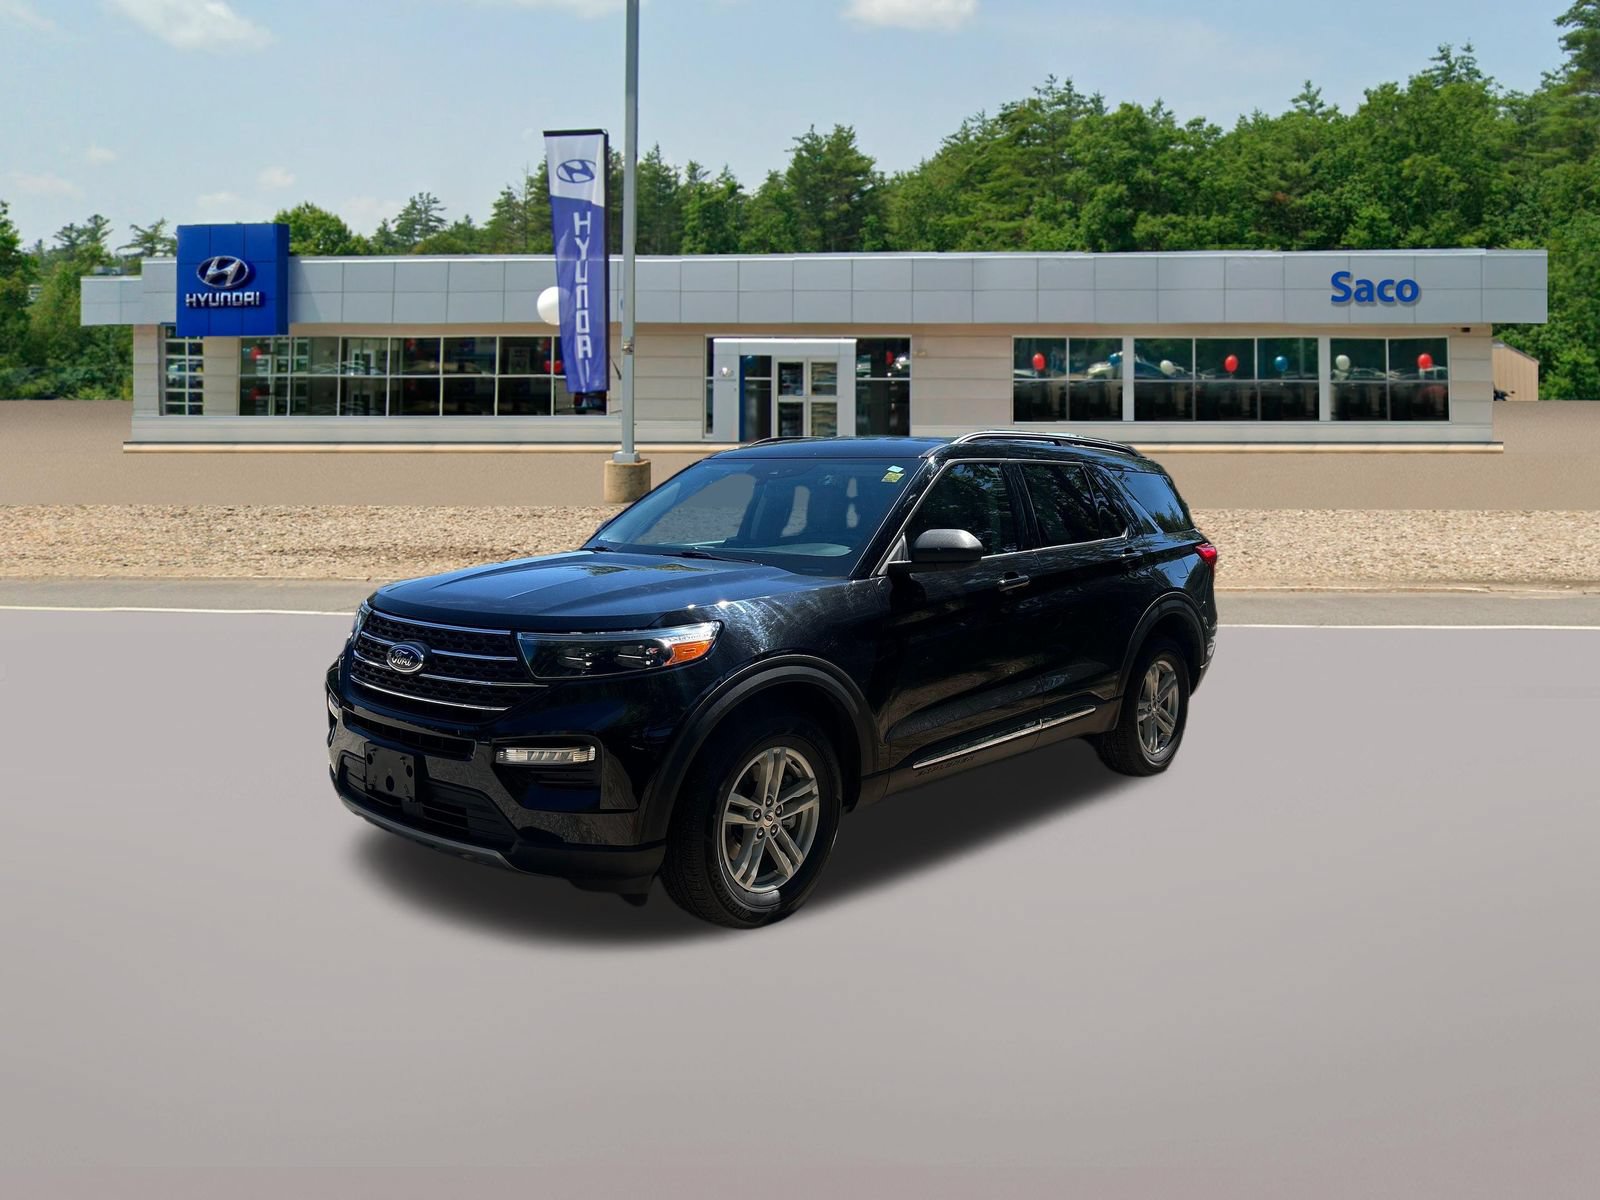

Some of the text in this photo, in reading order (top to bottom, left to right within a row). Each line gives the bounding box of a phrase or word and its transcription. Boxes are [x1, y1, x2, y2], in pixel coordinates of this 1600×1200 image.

[185, 291, 260, 307] HYUNDAI
[573, 211, 592, 383] HYUNDAI
[1330, 270, 1420, 304] Saco
[391, 648, 415, 667] Ford
